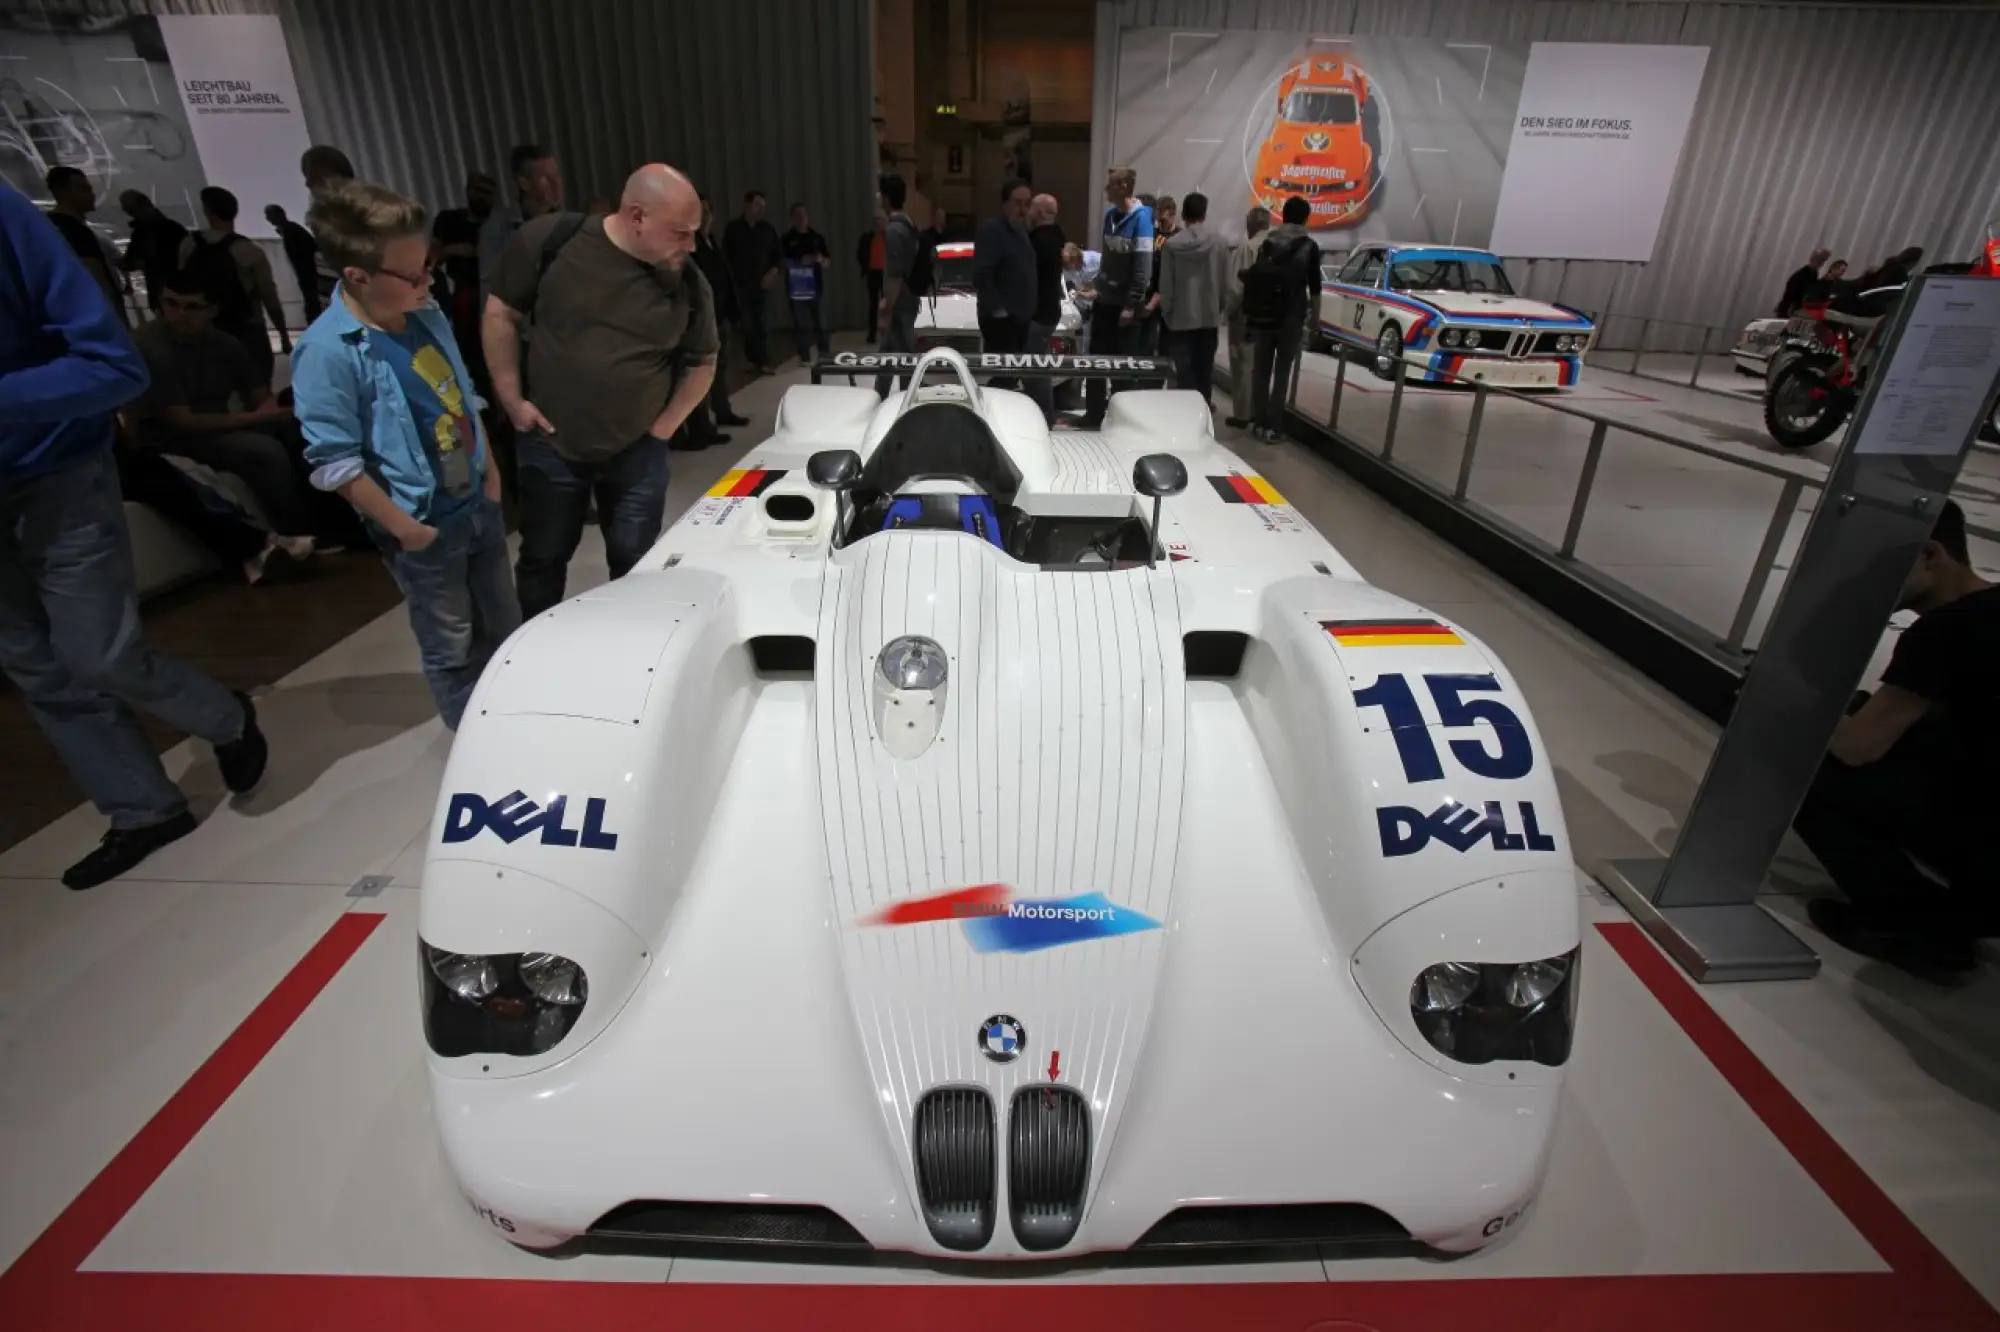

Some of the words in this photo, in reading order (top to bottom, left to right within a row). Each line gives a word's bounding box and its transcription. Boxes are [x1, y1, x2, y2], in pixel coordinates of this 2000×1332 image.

[183, 80, 252, 92] LEICHTBAU
[187, 93, 213, 104] SEIT
[1520, 117, 1545, 128] DEN
[1546, 117, 1574, 129] SIEG
[1575, 119, 1590, 129] IM
[1591, 119, 1632, 131] FOKUS.
[980, 353, 1065, 368] BMW
[1073, 356, 1156, 371] parts
[1353, 672, 1534, 784] 15
[442, 789, 618, 851] DELL
[1376, 800, 1556, 858] DELL
[952, 903, 1004, 917] BMW
[1008, 903, 1115, 922] Motorsport
